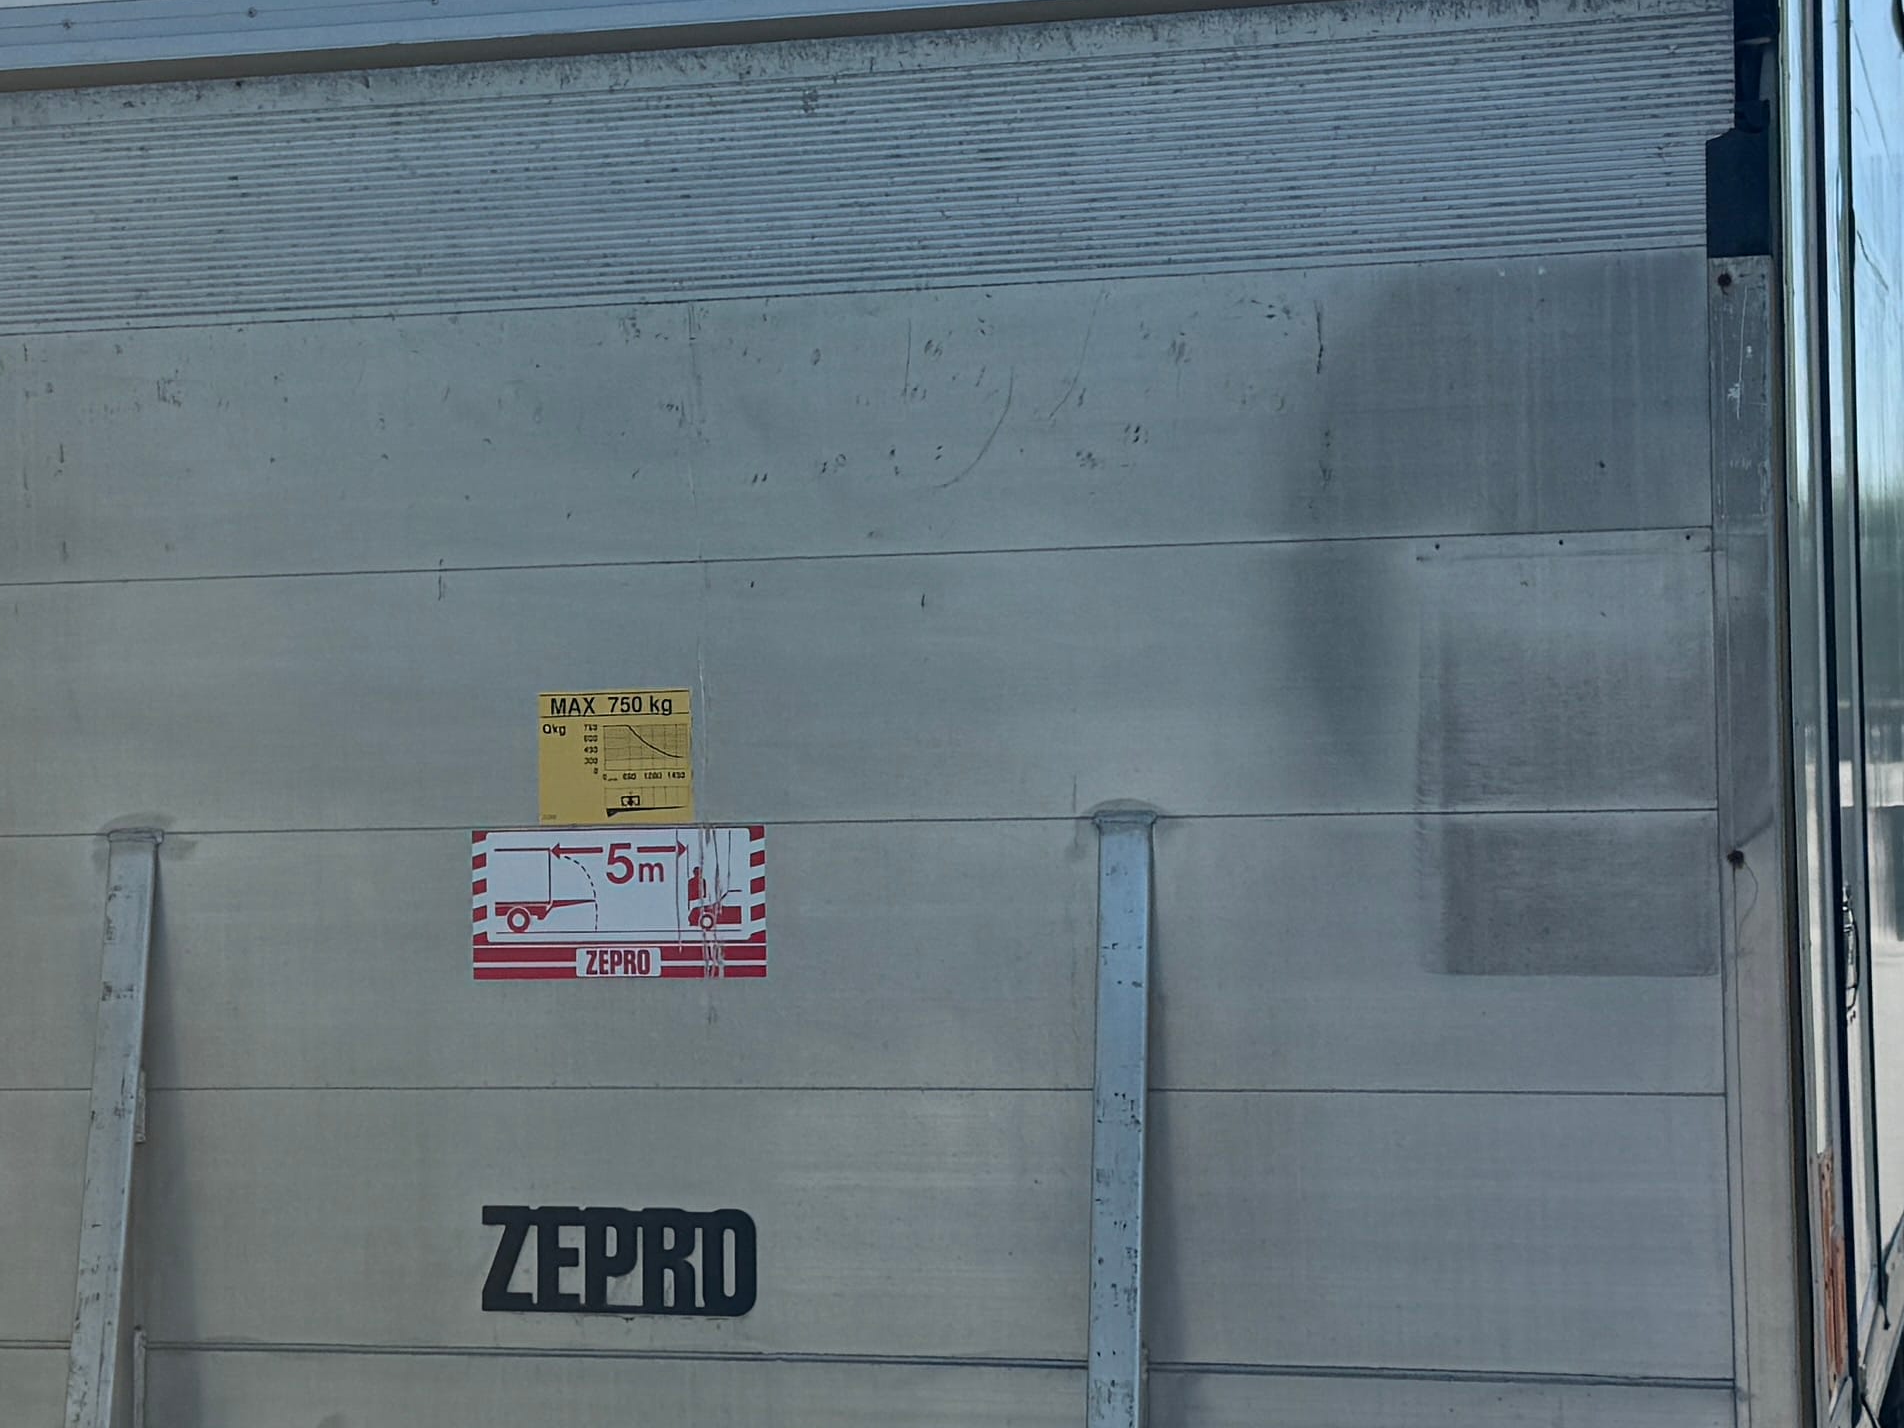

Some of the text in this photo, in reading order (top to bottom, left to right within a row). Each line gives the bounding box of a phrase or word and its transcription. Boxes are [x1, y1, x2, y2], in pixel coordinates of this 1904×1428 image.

[550, 695, 673, 716] MAX 750 kg
[586, 949, 651, 976] ZEPRO
[482, 1205, 757, 1316] ZEPRO
